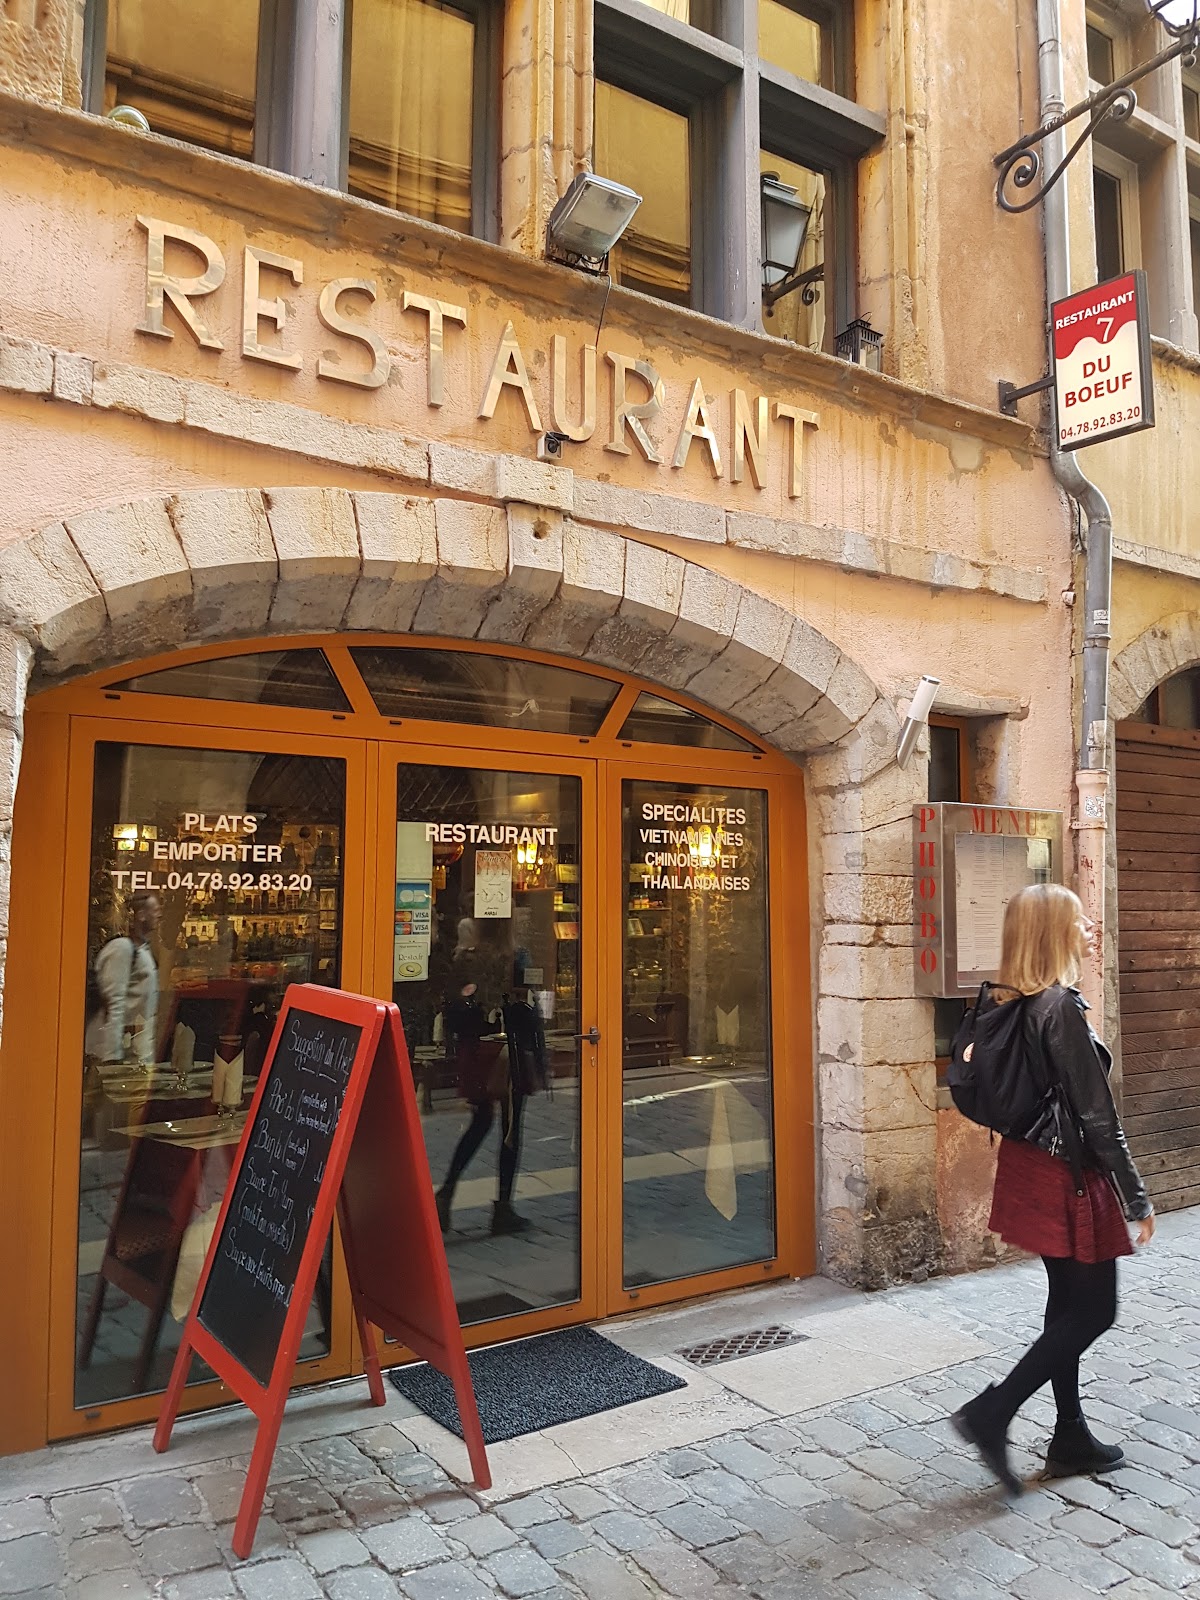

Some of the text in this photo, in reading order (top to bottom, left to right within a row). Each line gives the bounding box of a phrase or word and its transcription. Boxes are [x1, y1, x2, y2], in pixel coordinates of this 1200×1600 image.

[1055, 290, 1135, 330] RESTAURANT
[1096, 317, 1115, 342] 7
[136, 214, 821, 499] RESTAURANT
[1082, 355, 1111, 379] DU
[1064, 372, 1133, 408] BOEUF
[1060, 405, 1140, 440] 04.78.92.83.20
[184, 813, 258, 833] PLATS
[642, 803, 746, 824] SPECIALITES
[972, 808, 1038, 835] MENU
[425, 823, 558, 846] RESTAURANT
[640, 829, 743, 846] VIETNAMIENNES
[153, 842, 282, 863] EMPORTER
[645, 852, 738, 868] CHINOISES ET
[110, 870, 312, 891] TEL.04.78.92.83.20
[641, 875, 750, 890] THAILANDAISES
